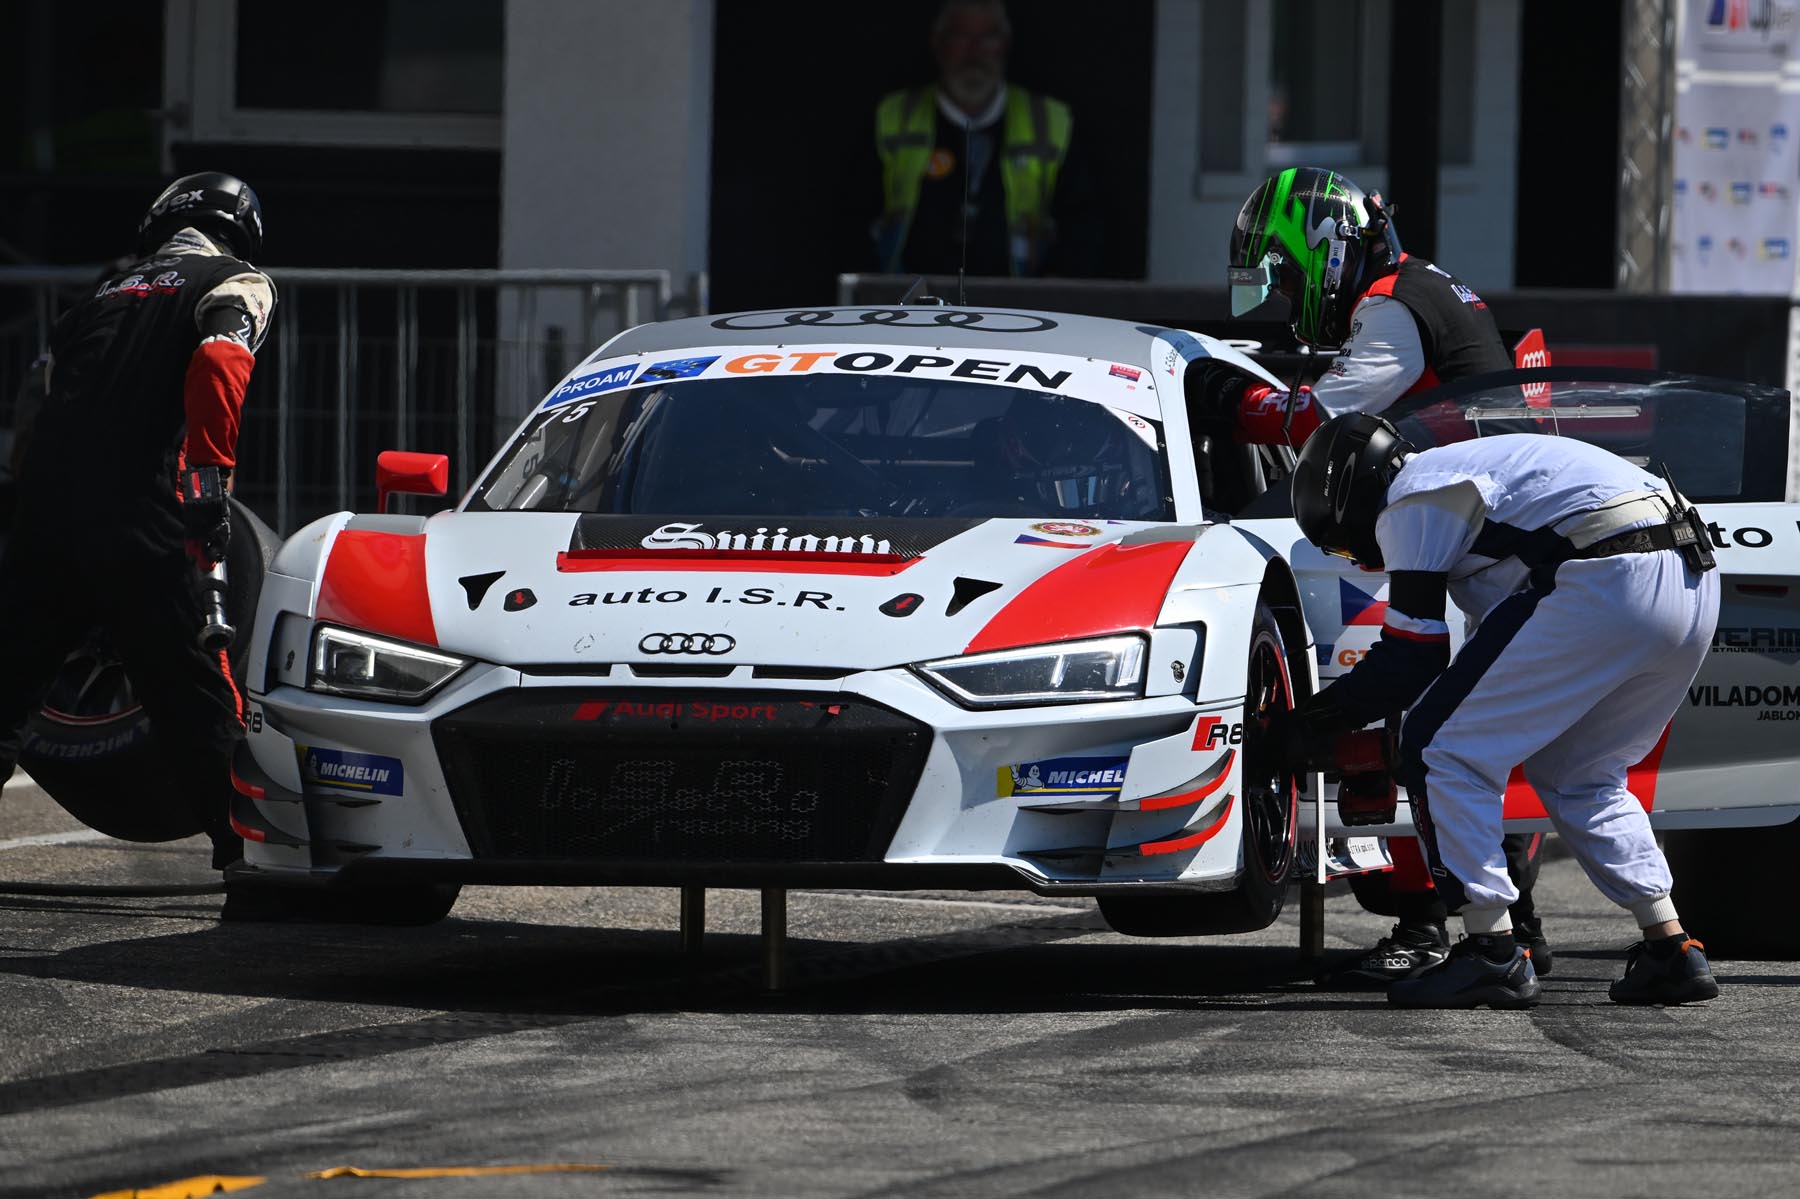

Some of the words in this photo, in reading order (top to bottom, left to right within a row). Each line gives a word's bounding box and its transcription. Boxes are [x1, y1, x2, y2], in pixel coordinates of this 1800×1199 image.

[556, 369, 633, 398] PROAM
[541, 401, 597, 427] 75
[569, 588, 688, 606] auto
[705, 587, 846, 611] I.S.R.
[613, 701, 682, 718] Audi
[690, 702, 778, 721] Sport
[1206, 722, 1243, 746] R8
[320, 762, 390, 783] MICHELIN
[1048, 769, 1125, 785] MICHEL
